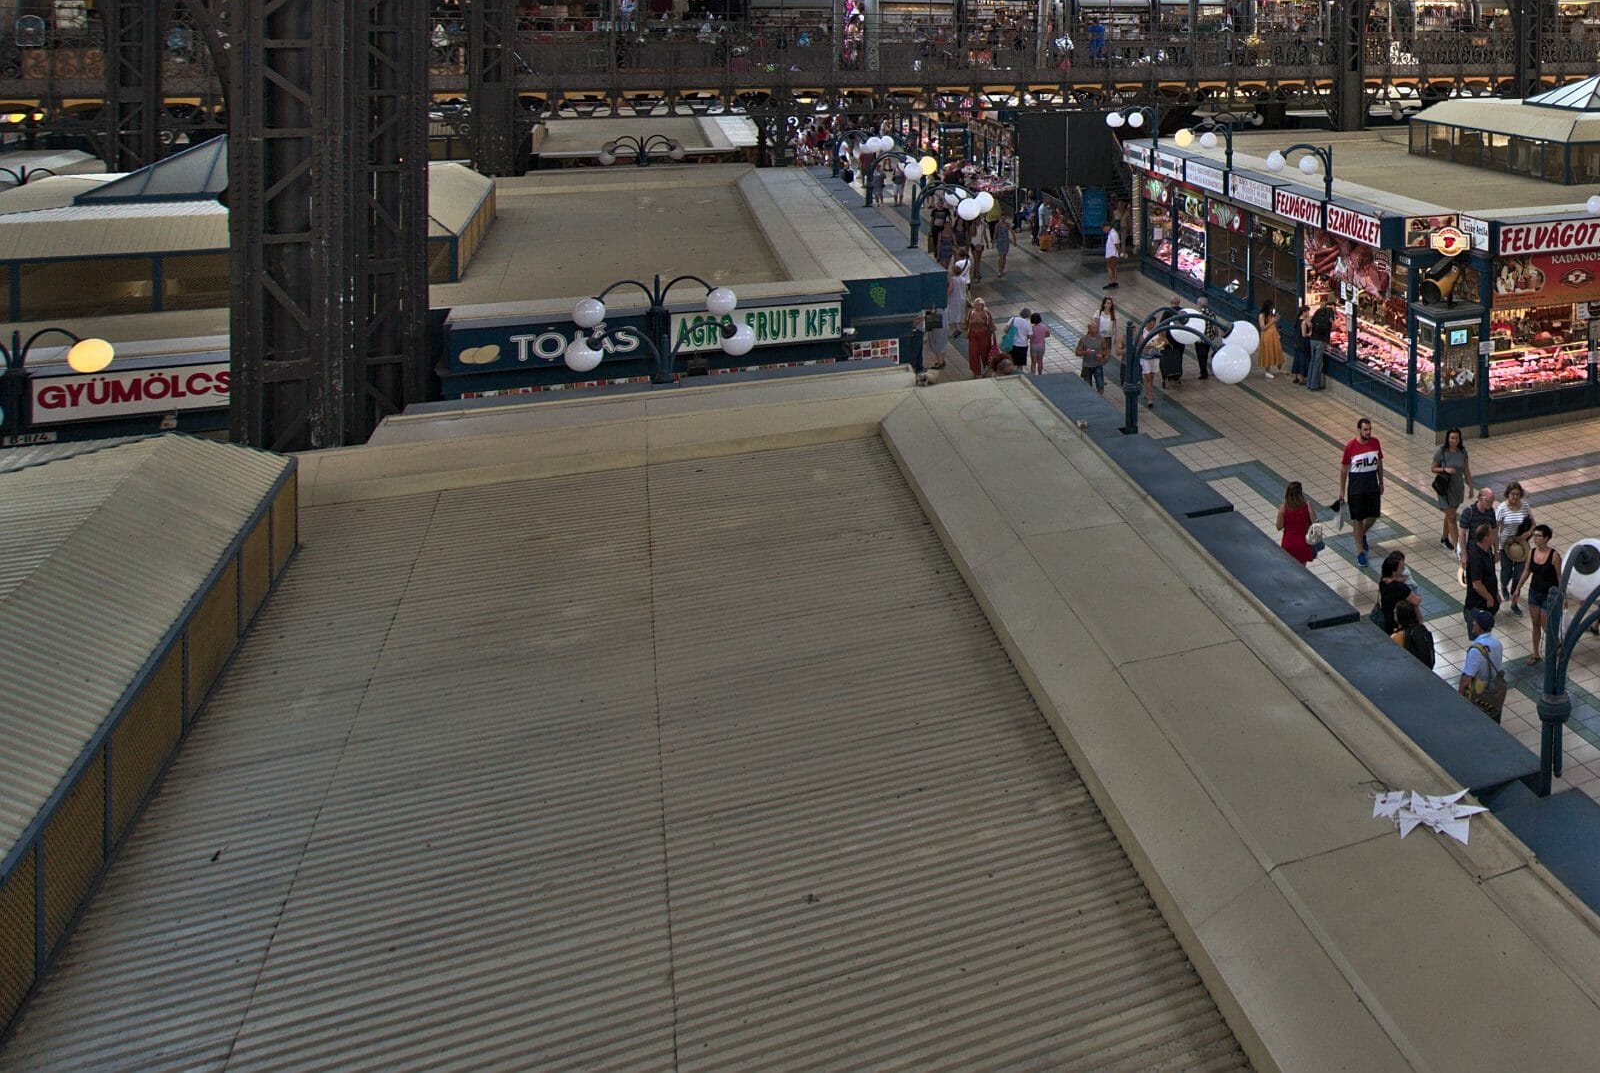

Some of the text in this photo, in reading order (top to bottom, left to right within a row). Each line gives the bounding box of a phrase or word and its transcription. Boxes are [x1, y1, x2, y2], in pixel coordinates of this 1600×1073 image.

[1276, 191, 1321, 225] FELVÁGOTT
[1327, 208, 1381, 245] SZAKÜZLET
[805, 307, 841, 336] KFT.
[37, 370, 231, 410] GYÜMÖLCS
[1355, 456, 1378, 468] FILA
